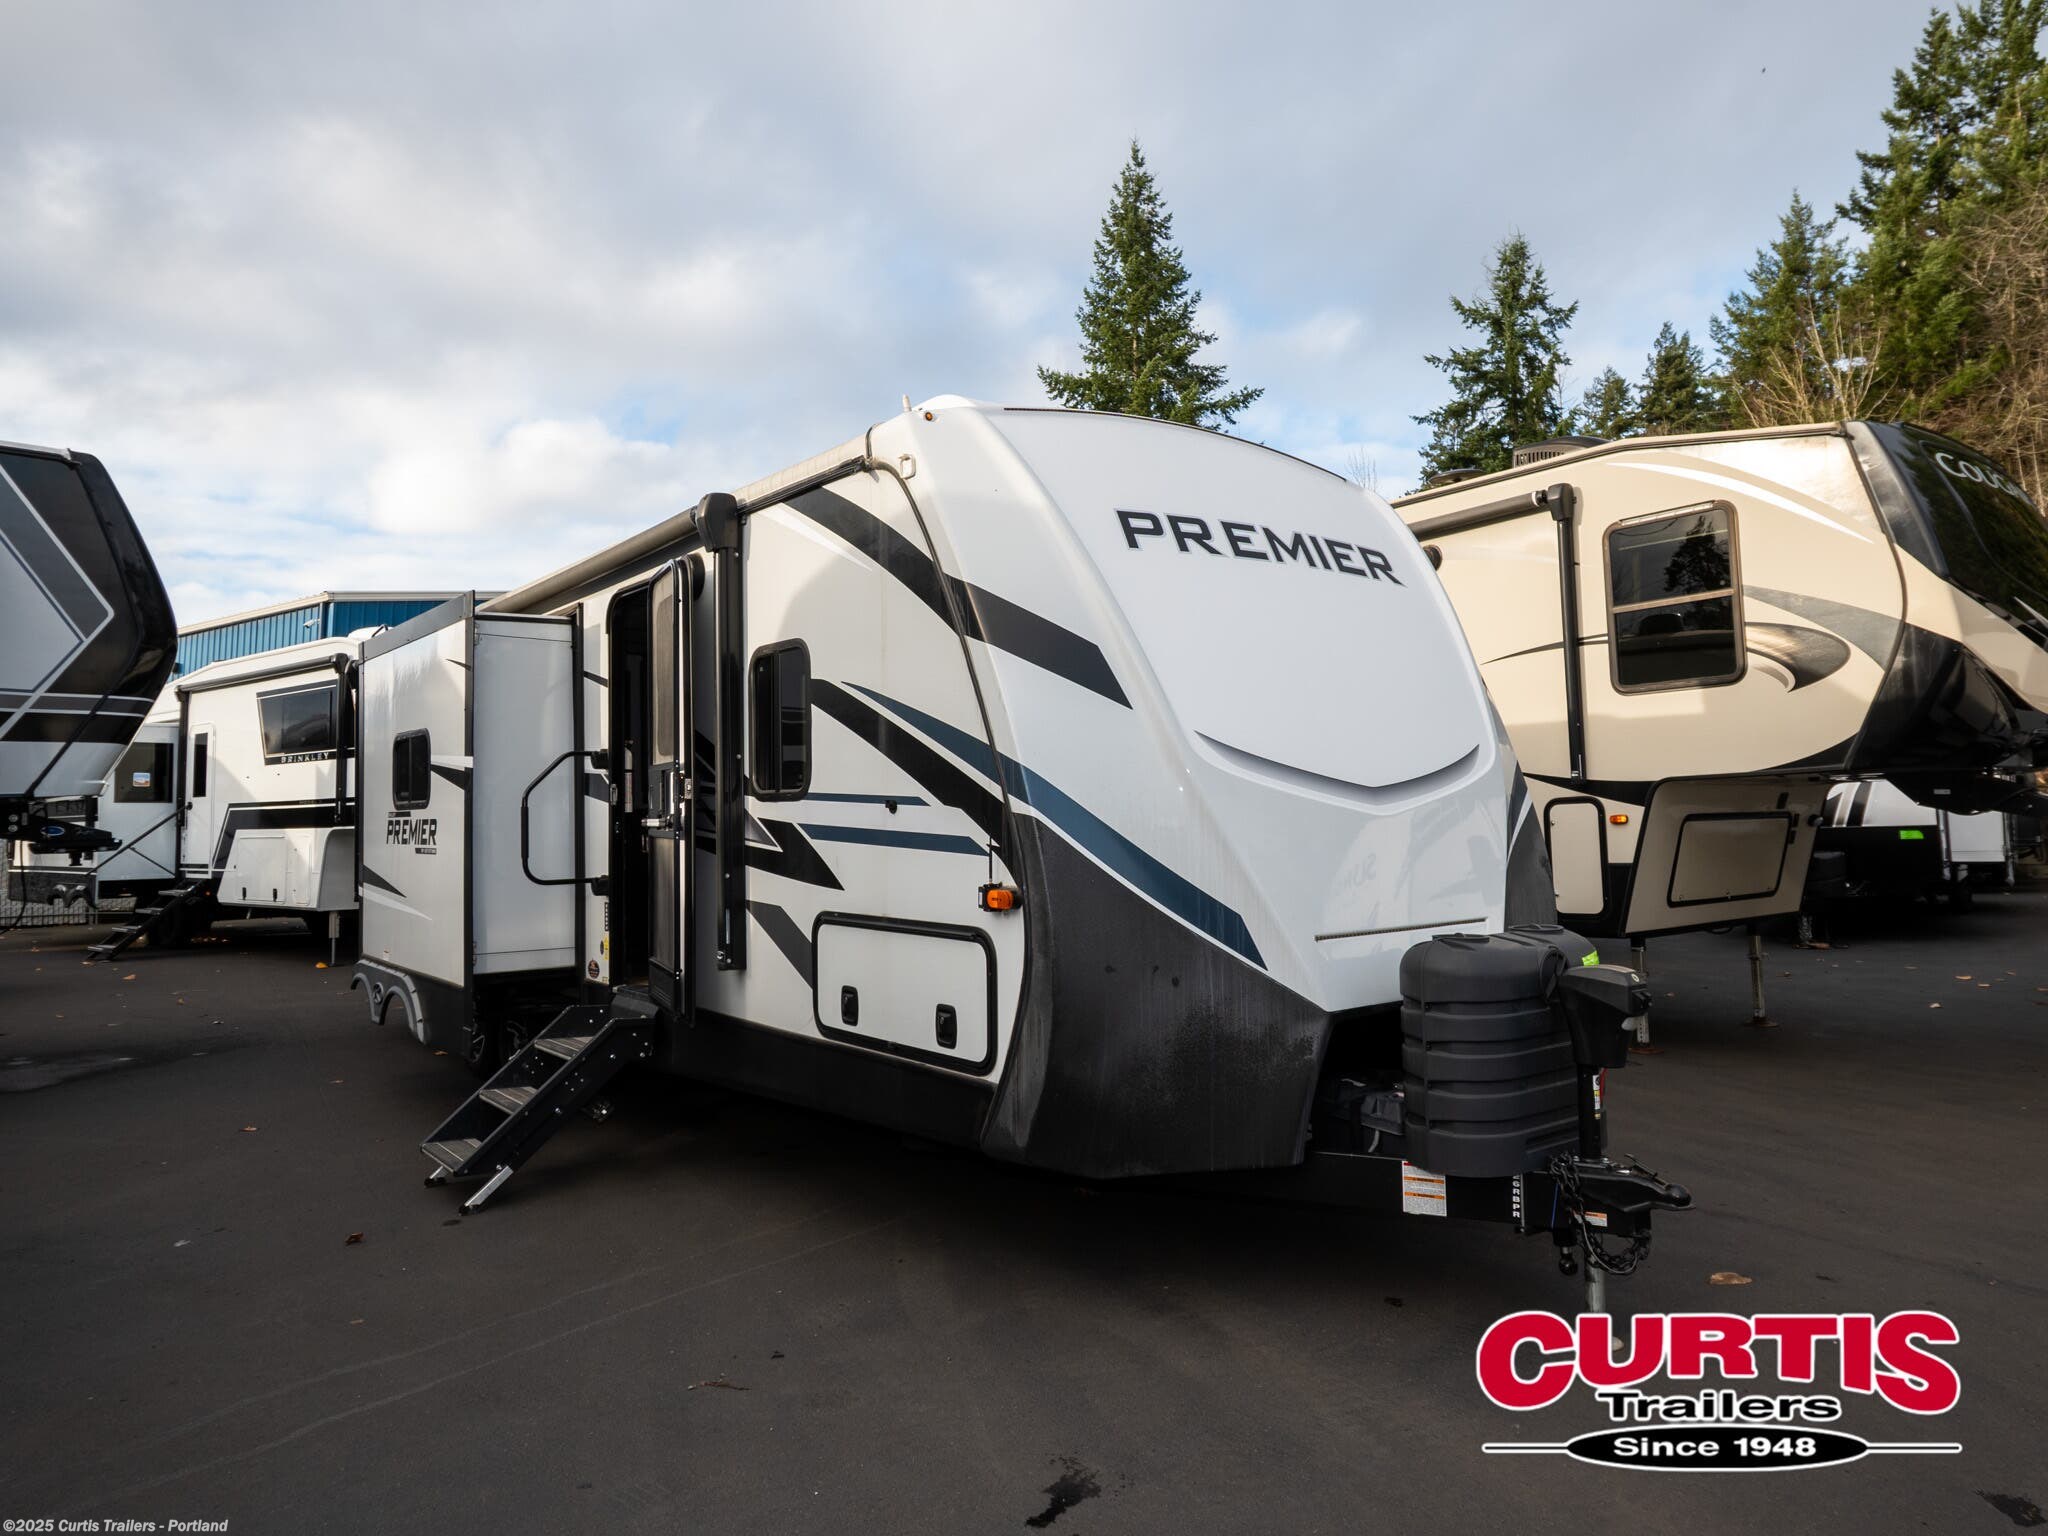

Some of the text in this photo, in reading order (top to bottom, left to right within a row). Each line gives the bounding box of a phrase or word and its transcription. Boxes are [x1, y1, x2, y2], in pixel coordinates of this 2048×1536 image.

[1935, 452, 2038, 510] COUG
[1115, 509, 1407, 588] PREMIER
[281, 752, 329, 763] BRINKLEY
[386, 818, 437, 846] PREMIER
